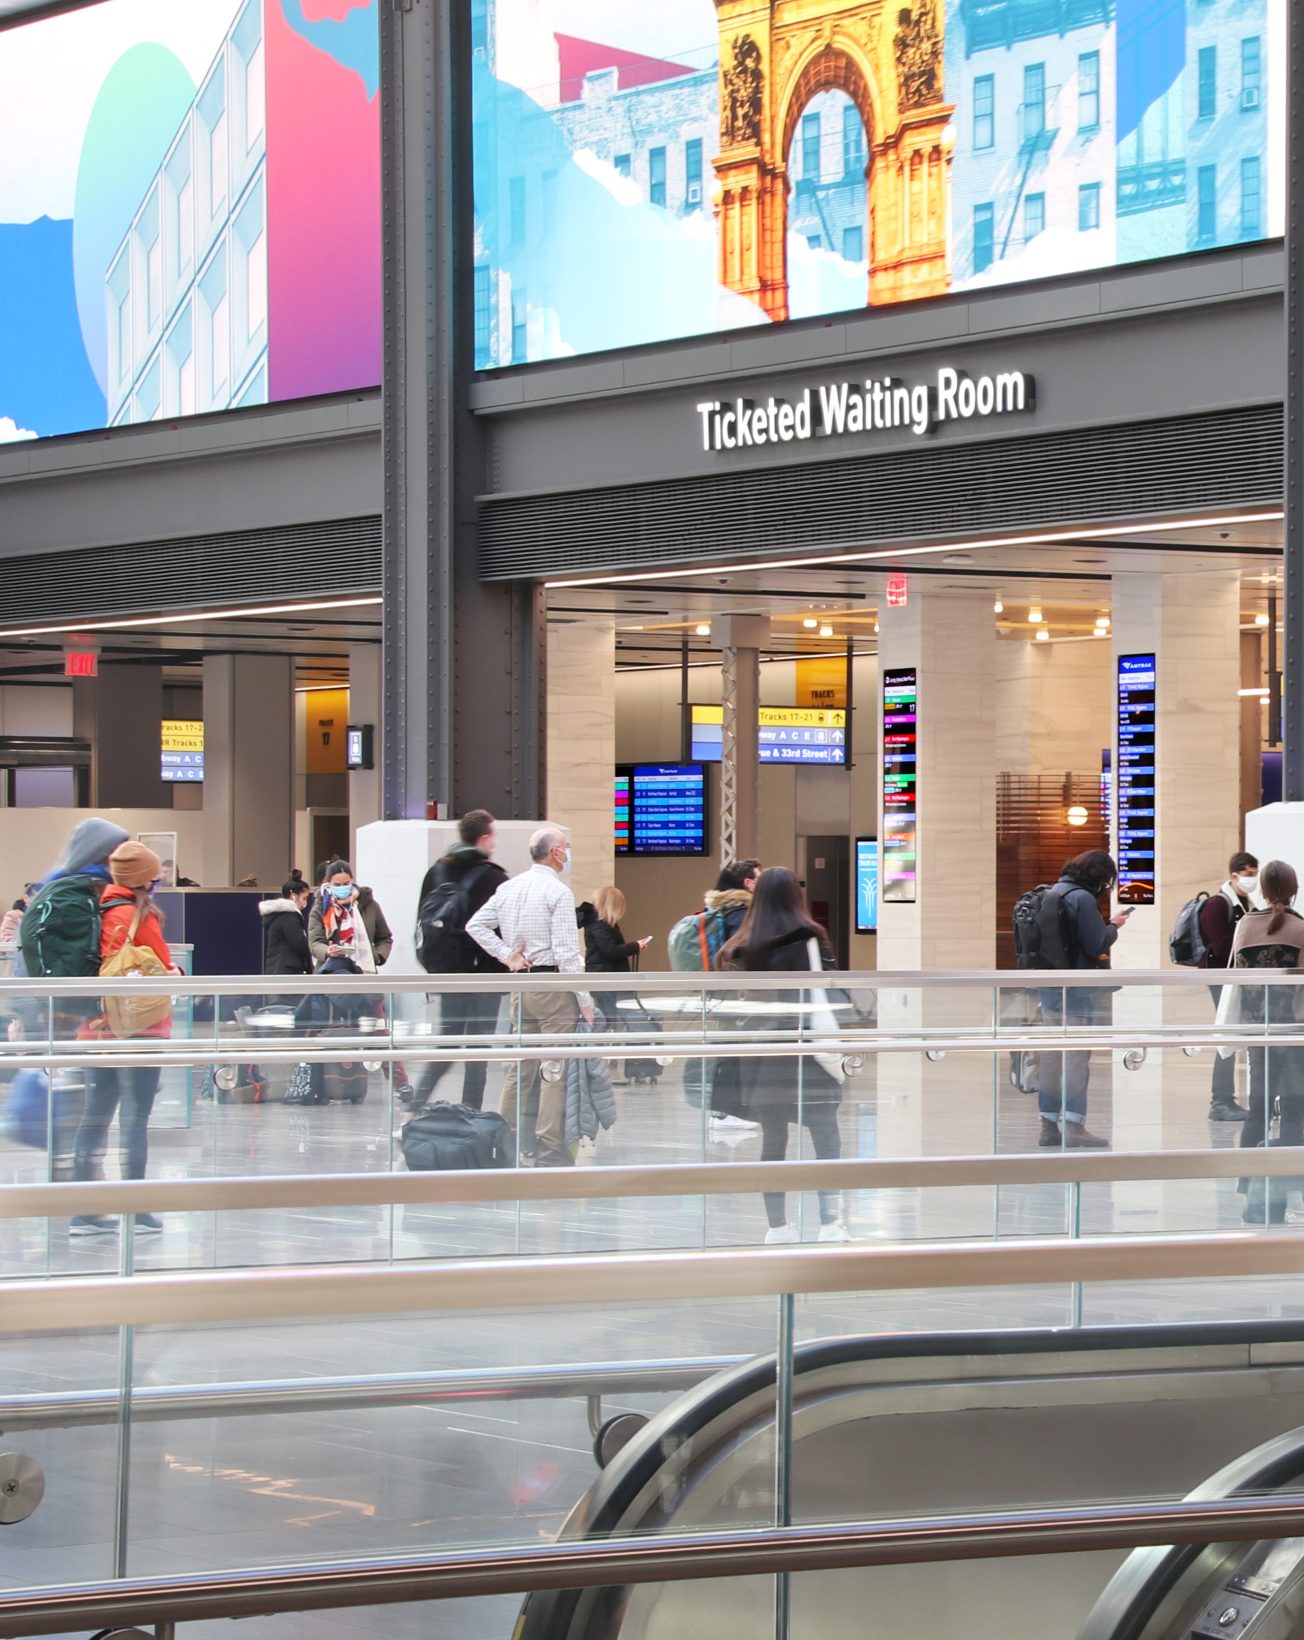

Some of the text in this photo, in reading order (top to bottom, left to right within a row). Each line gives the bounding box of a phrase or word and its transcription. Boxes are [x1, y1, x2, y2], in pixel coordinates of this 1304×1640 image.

[697, 367, 1025, 451] Ticketed Waiting Room
[811, 690, 835, 699] TRACKS
[760, 712, 813, 721] Tracks 17-21
[759, 731, 811, 741] way A C E
[172, 739, 197, 747] Tracks
[772, 748, 779, 757] &
[781, 749, 800, 758] 33rd
[802, 749, 828, 758] Street
[184, 755, 191, 763] A
[195, 755, 202, 763] C
[176, 770, 183, 778] A
[187, 770, 194, 778] C
